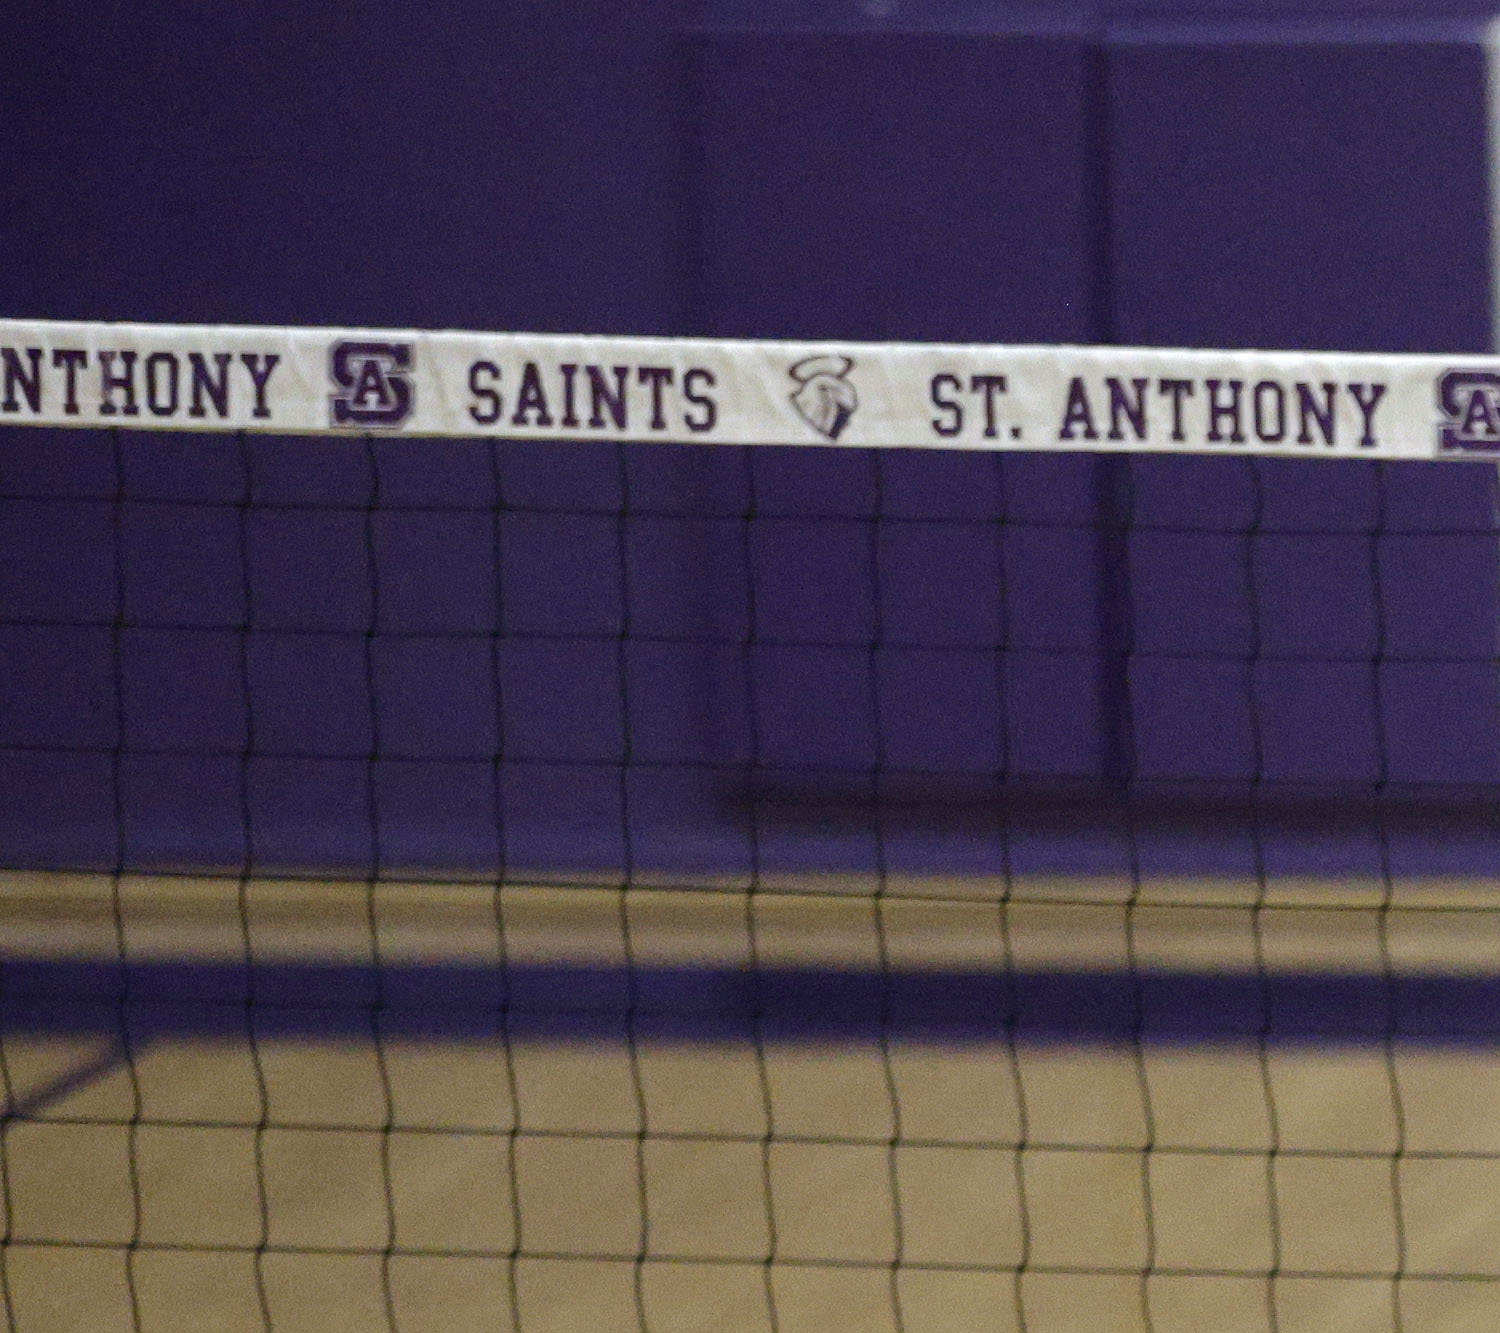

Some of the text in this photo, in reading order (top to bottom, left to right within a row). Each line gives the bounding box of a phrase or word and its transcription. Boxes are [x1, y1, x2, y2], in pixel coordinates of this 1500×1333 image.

[466, 358, 719, 435] SAINTS
[928, 371, 1024, 442] ST.
[1057, 375, 1389, 449] ANTHONY
